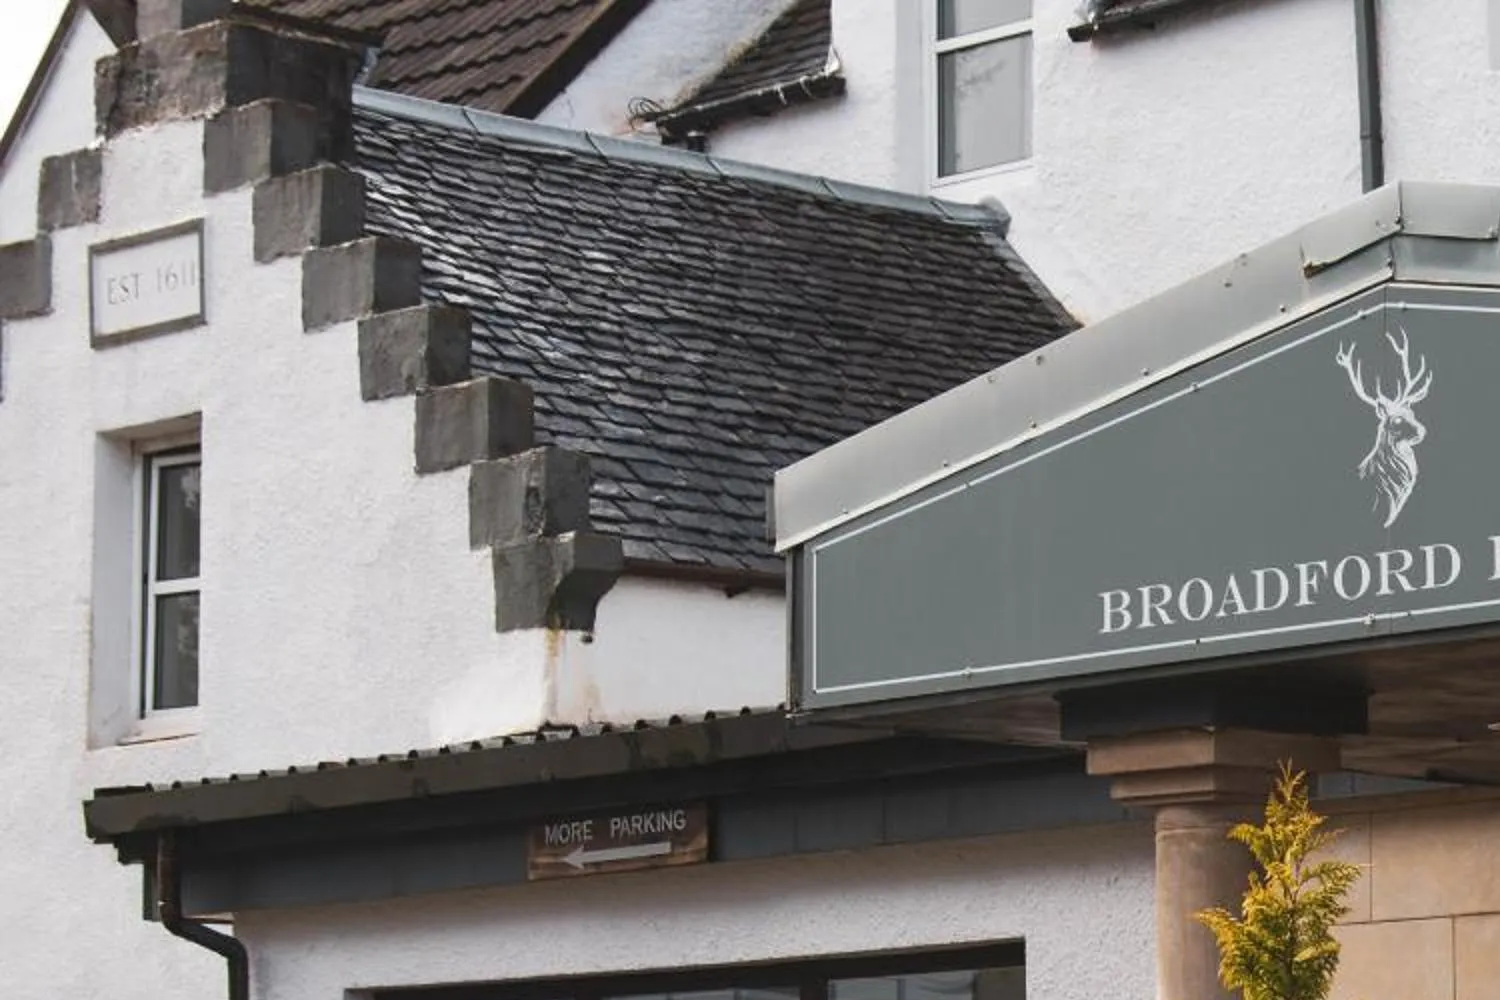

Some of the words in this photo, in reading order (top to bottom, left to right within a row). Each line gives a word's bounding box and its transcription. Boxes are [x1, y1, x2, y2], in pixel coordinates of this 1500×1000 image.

[107, 272, 142, 305] EST
[156, 260, 196, 293] 1611
[1098, 542, 1462, 633] BROADFORD
[544, 820, 593, 845] MORE
[609, 809, 687, 838] PARKING
